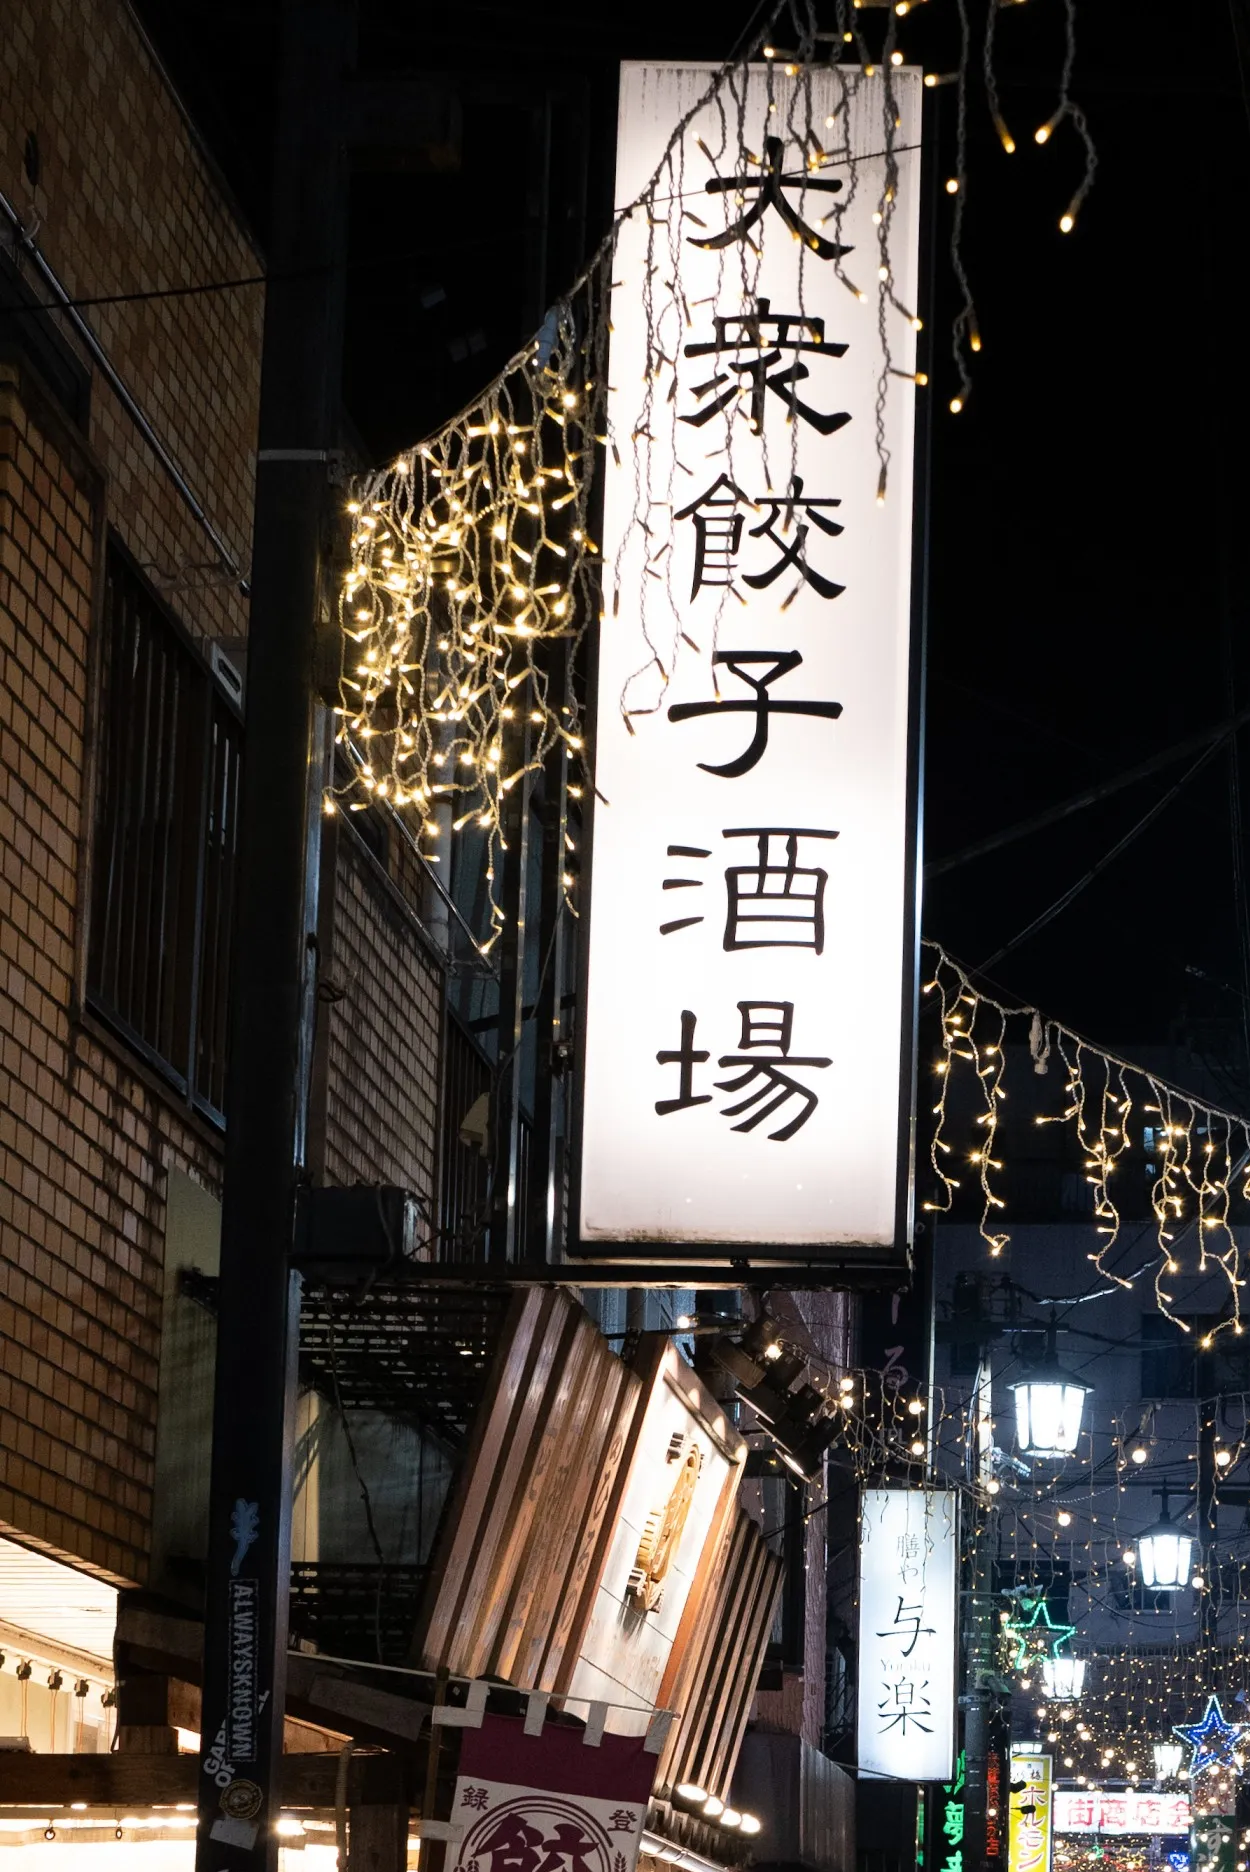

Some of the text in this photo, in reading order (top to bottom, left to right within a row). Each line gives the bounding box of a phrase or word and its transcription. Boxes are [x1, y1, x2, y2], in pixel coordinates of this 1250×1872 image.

[654, 136, 854, 1142] 大衆餃子酒場
[897, 1534, 920, 1584] 膳や
[231, 1583, 255, 1758] ALWAYSKNOWN
[876, 1595, 936, 1737] 与楽
[1016, 1785, 1047, 1870] ホルモン
[1053, 1799, 1190, 1828] 街商店会
